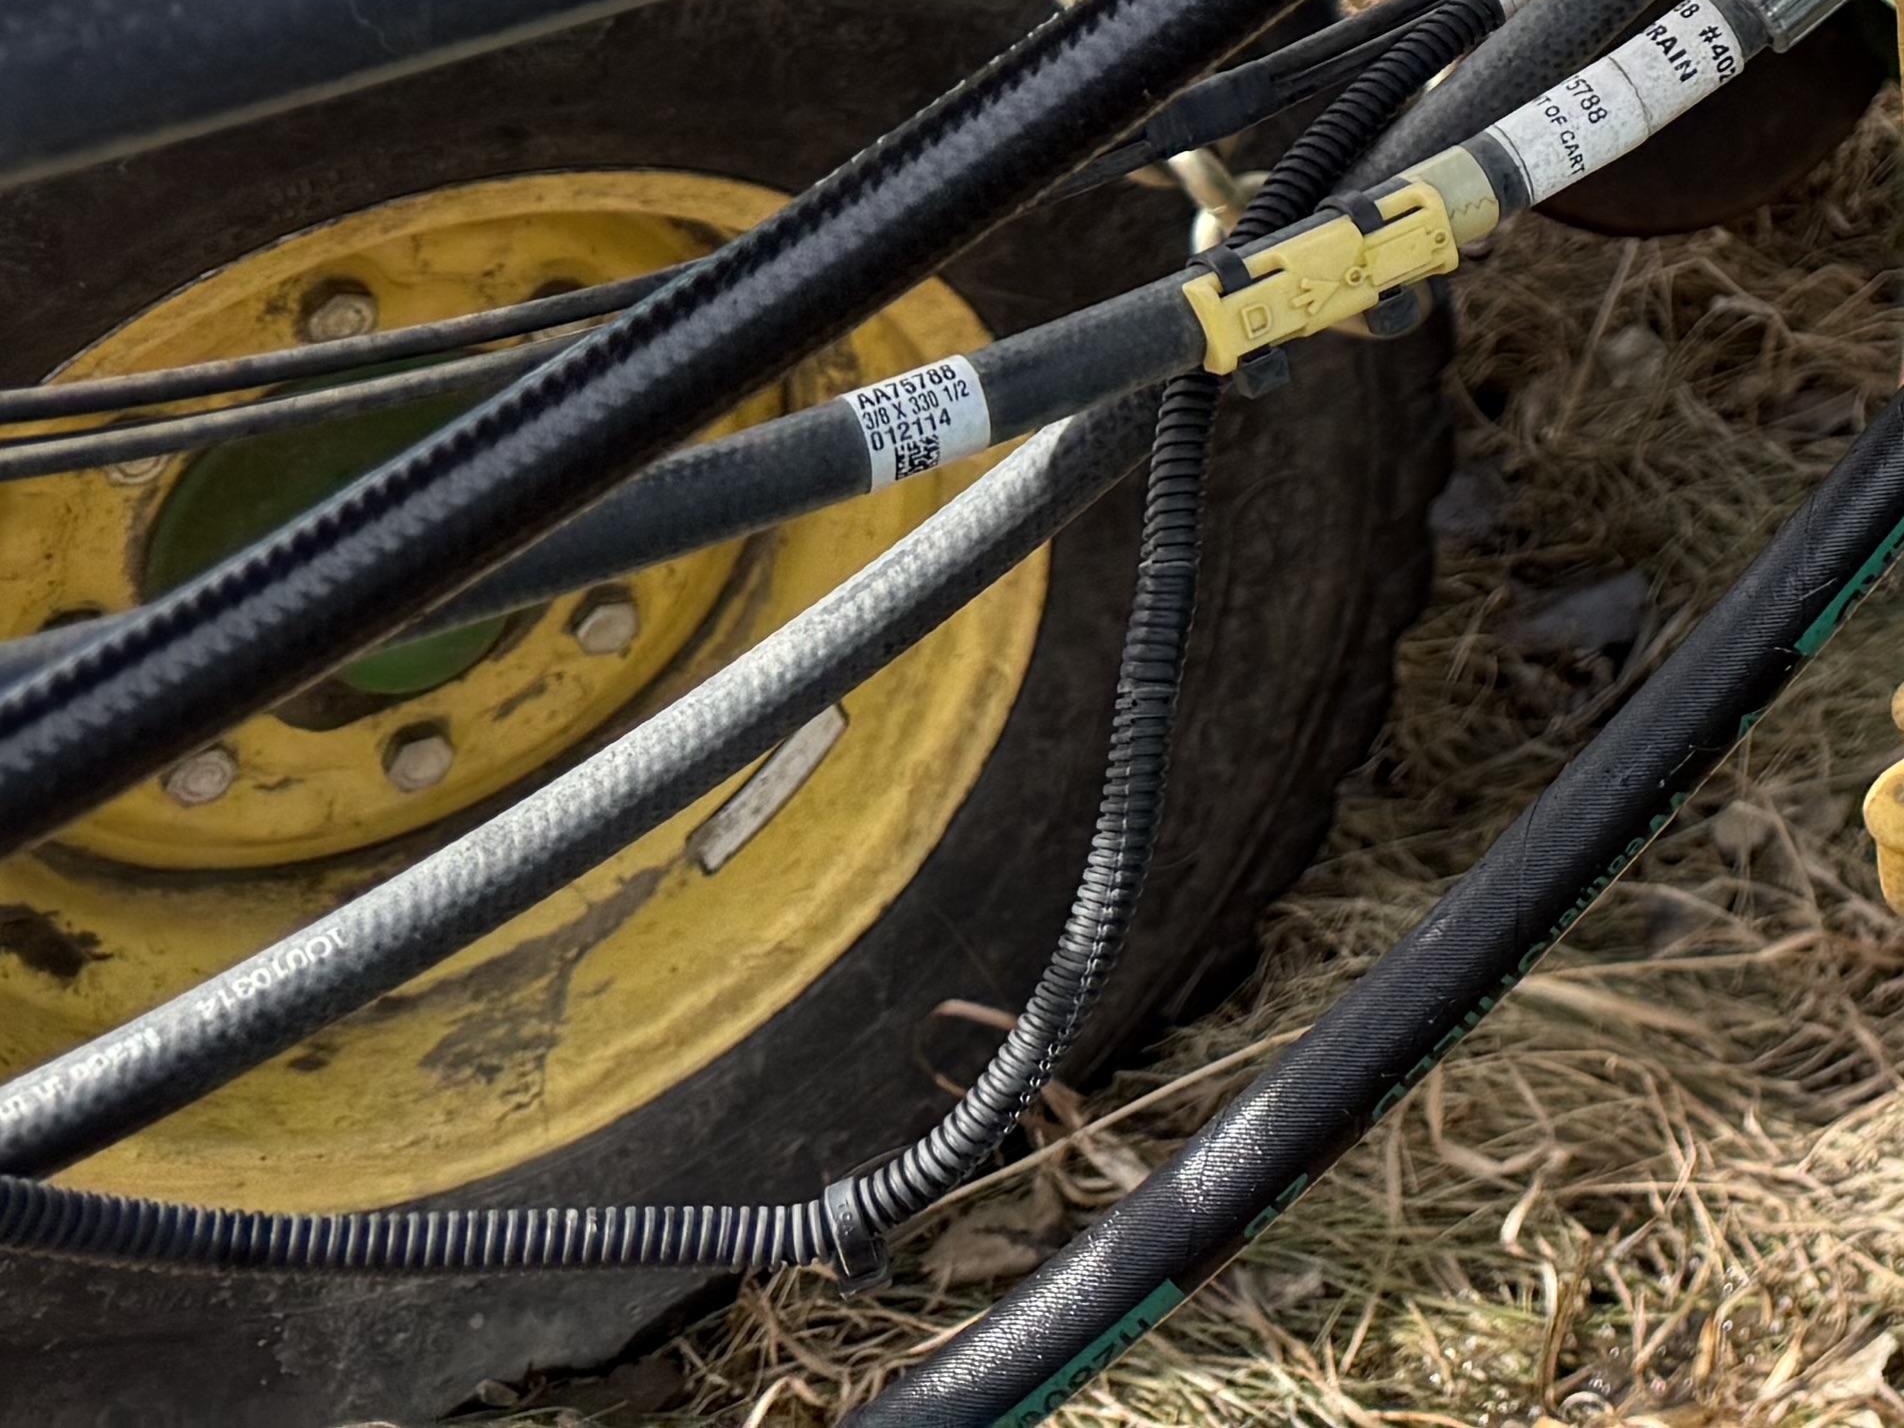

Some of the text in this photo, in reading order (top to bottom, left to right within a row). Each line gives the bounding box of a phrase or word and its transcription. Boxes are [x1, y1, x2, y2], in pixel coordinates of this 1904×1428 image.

[1543, 102, 1568, 130] OF
[856, 363, 956, 410] AA75788
[861, 378, 970, 431] 3/8 X 330 1/2
[868, 407, 953, 452] 012114
